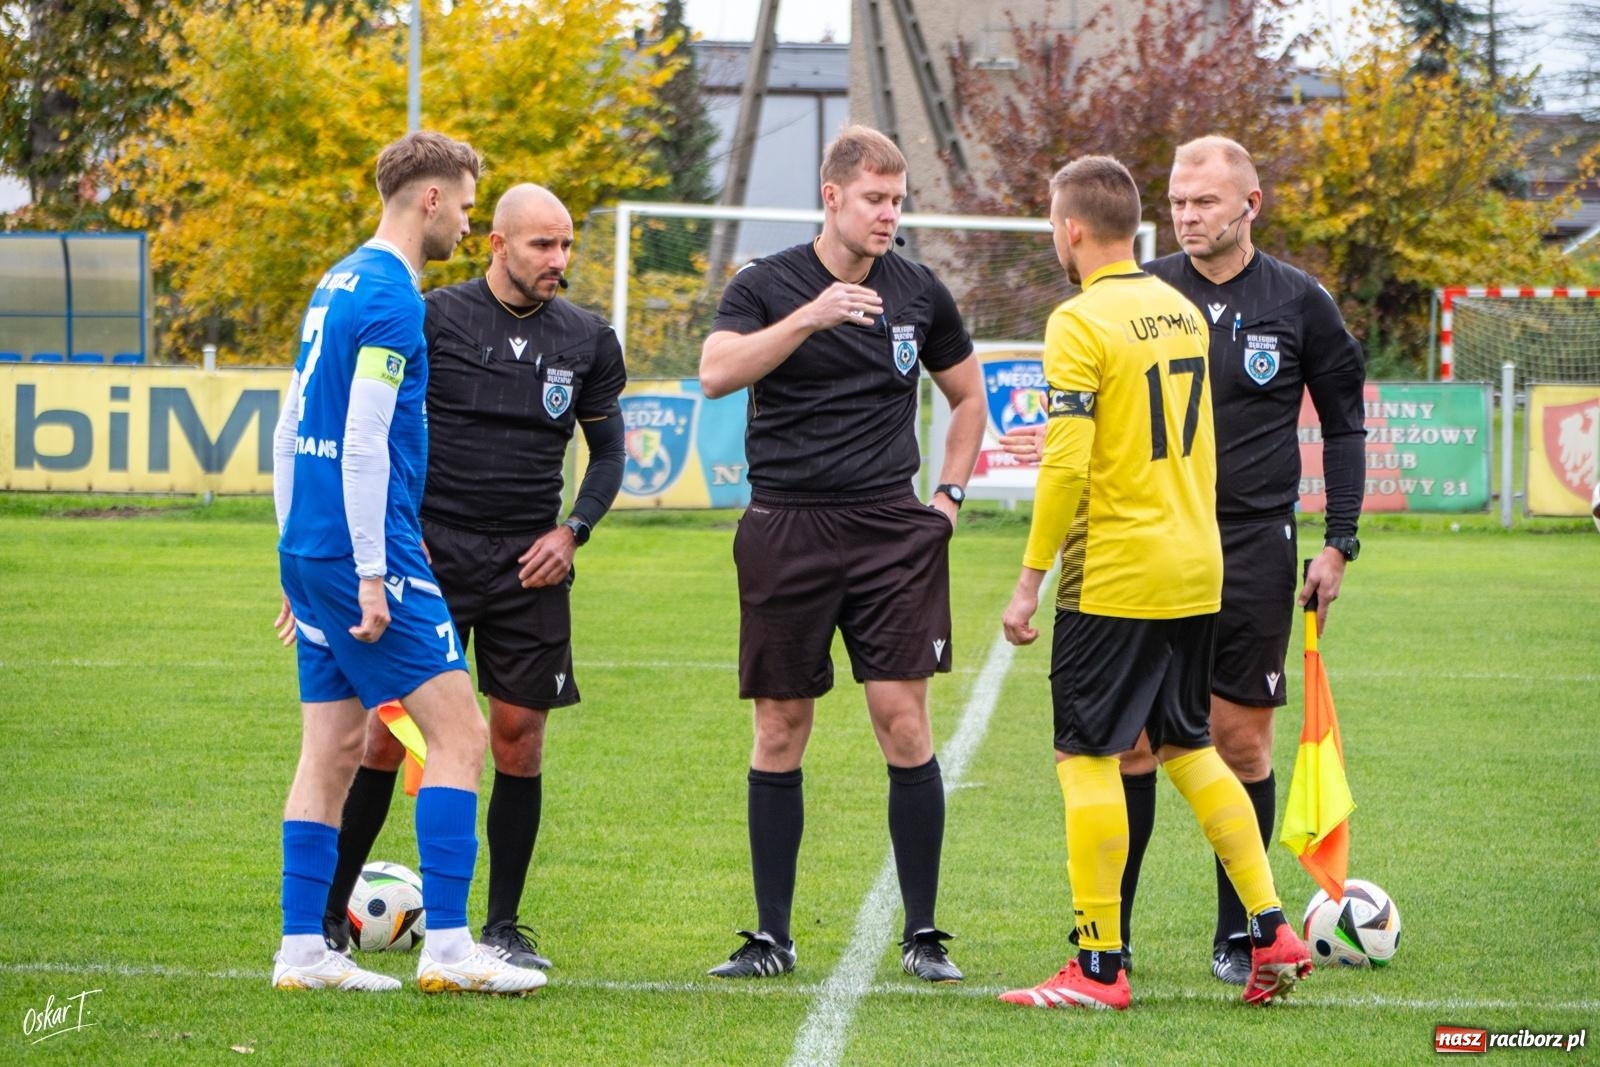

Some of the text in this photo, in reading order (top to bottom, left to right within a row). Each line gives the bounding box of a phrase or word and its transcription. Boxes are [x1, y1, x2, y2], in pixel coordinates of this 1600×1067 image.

[298, 306, 329, 421] 7
[1144, 356, 1206, 462] 17
[1365, 453, 1417, 470] LUB
[1442, 481, 1469, 496] 21
[435, 620, 460, 663] 7
